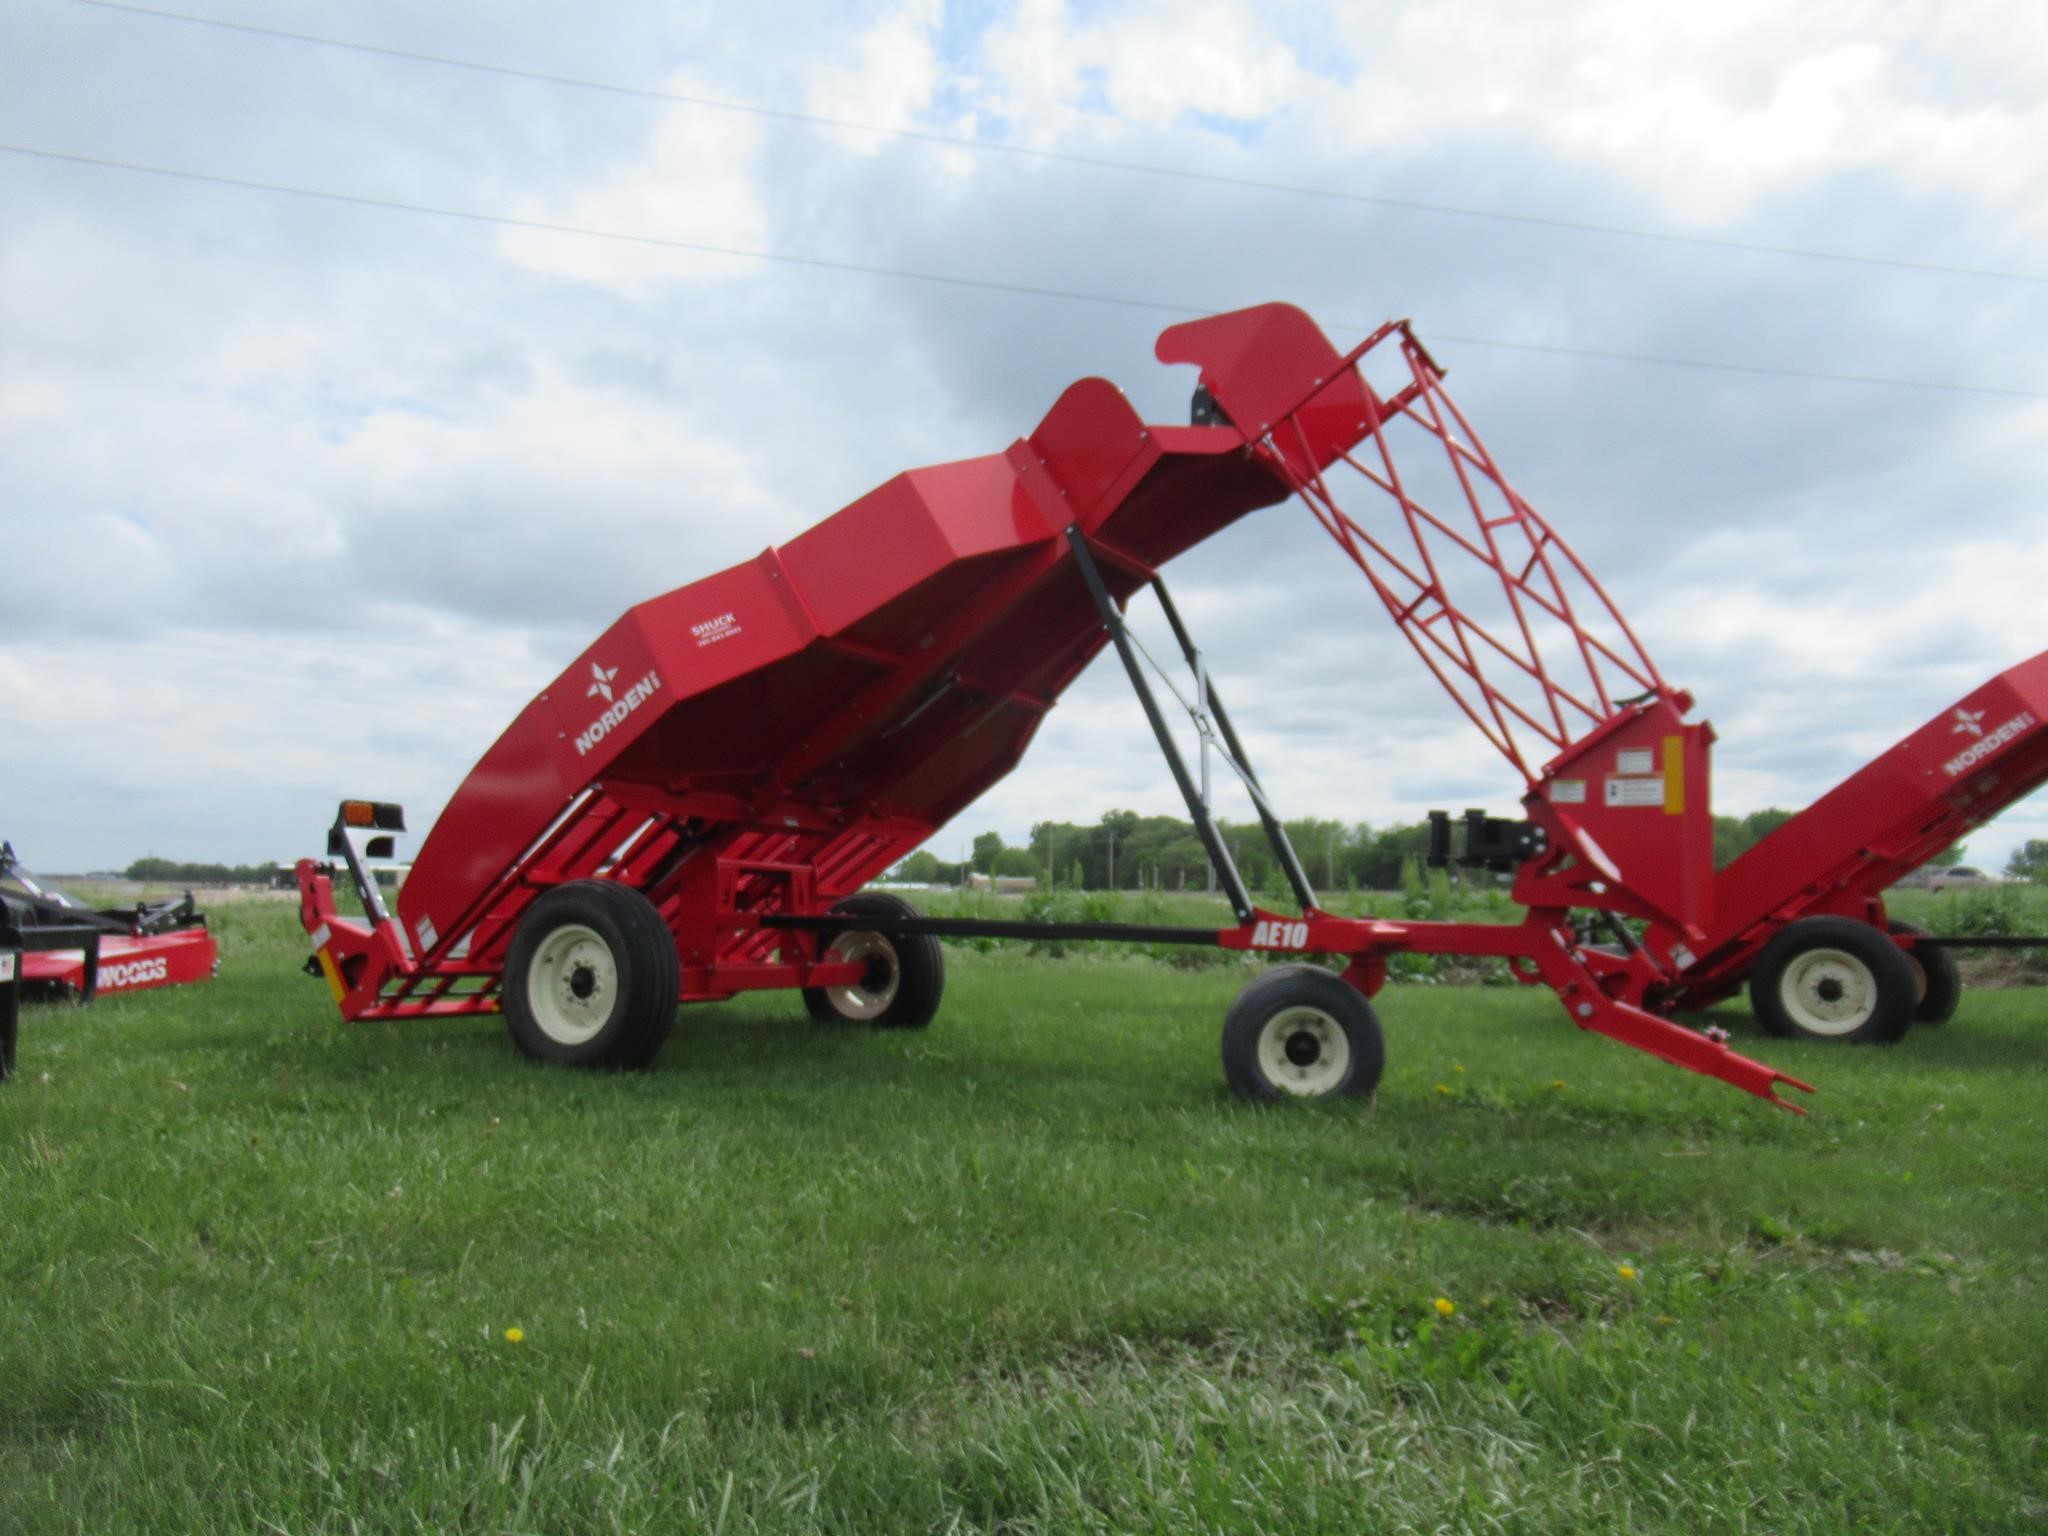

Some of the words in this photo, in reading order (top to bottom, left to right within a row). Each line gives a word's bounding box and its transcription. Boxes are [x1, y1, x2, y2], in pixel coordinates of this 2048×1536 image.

[691, 612, 737, 636] SHUCK
[575, 677, 655, 756] NORDEN
[1943, 714, 2028, 776] NORDEN
[1251, 921, 1309, 949] AE10
[96, 957, 168, 989] WOODS
